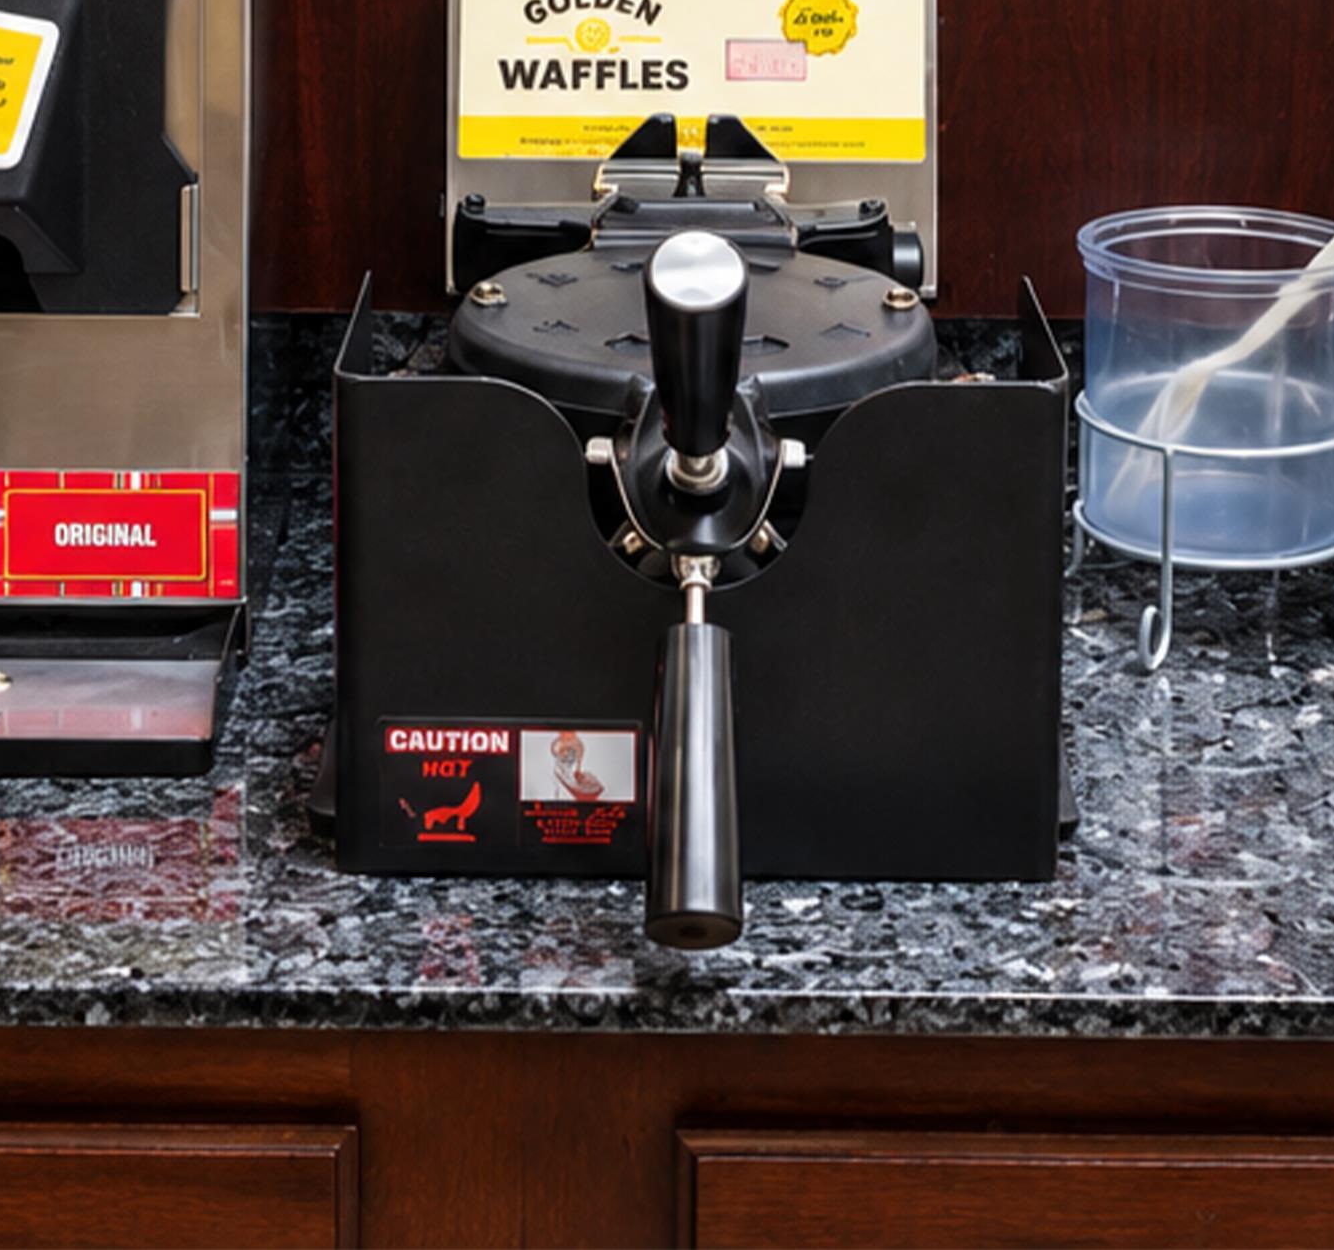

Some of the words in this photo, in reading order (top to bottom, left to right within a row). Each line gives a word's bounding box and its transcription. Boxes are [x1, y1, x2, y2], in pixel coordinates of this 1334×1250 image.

[498, 60, 690, 92] WAFFLES
[54, 523, 156, 548] ORIGINAL
[390, 730, 509, 752] CAUTION
[422, 759, 471, 779] HOT
